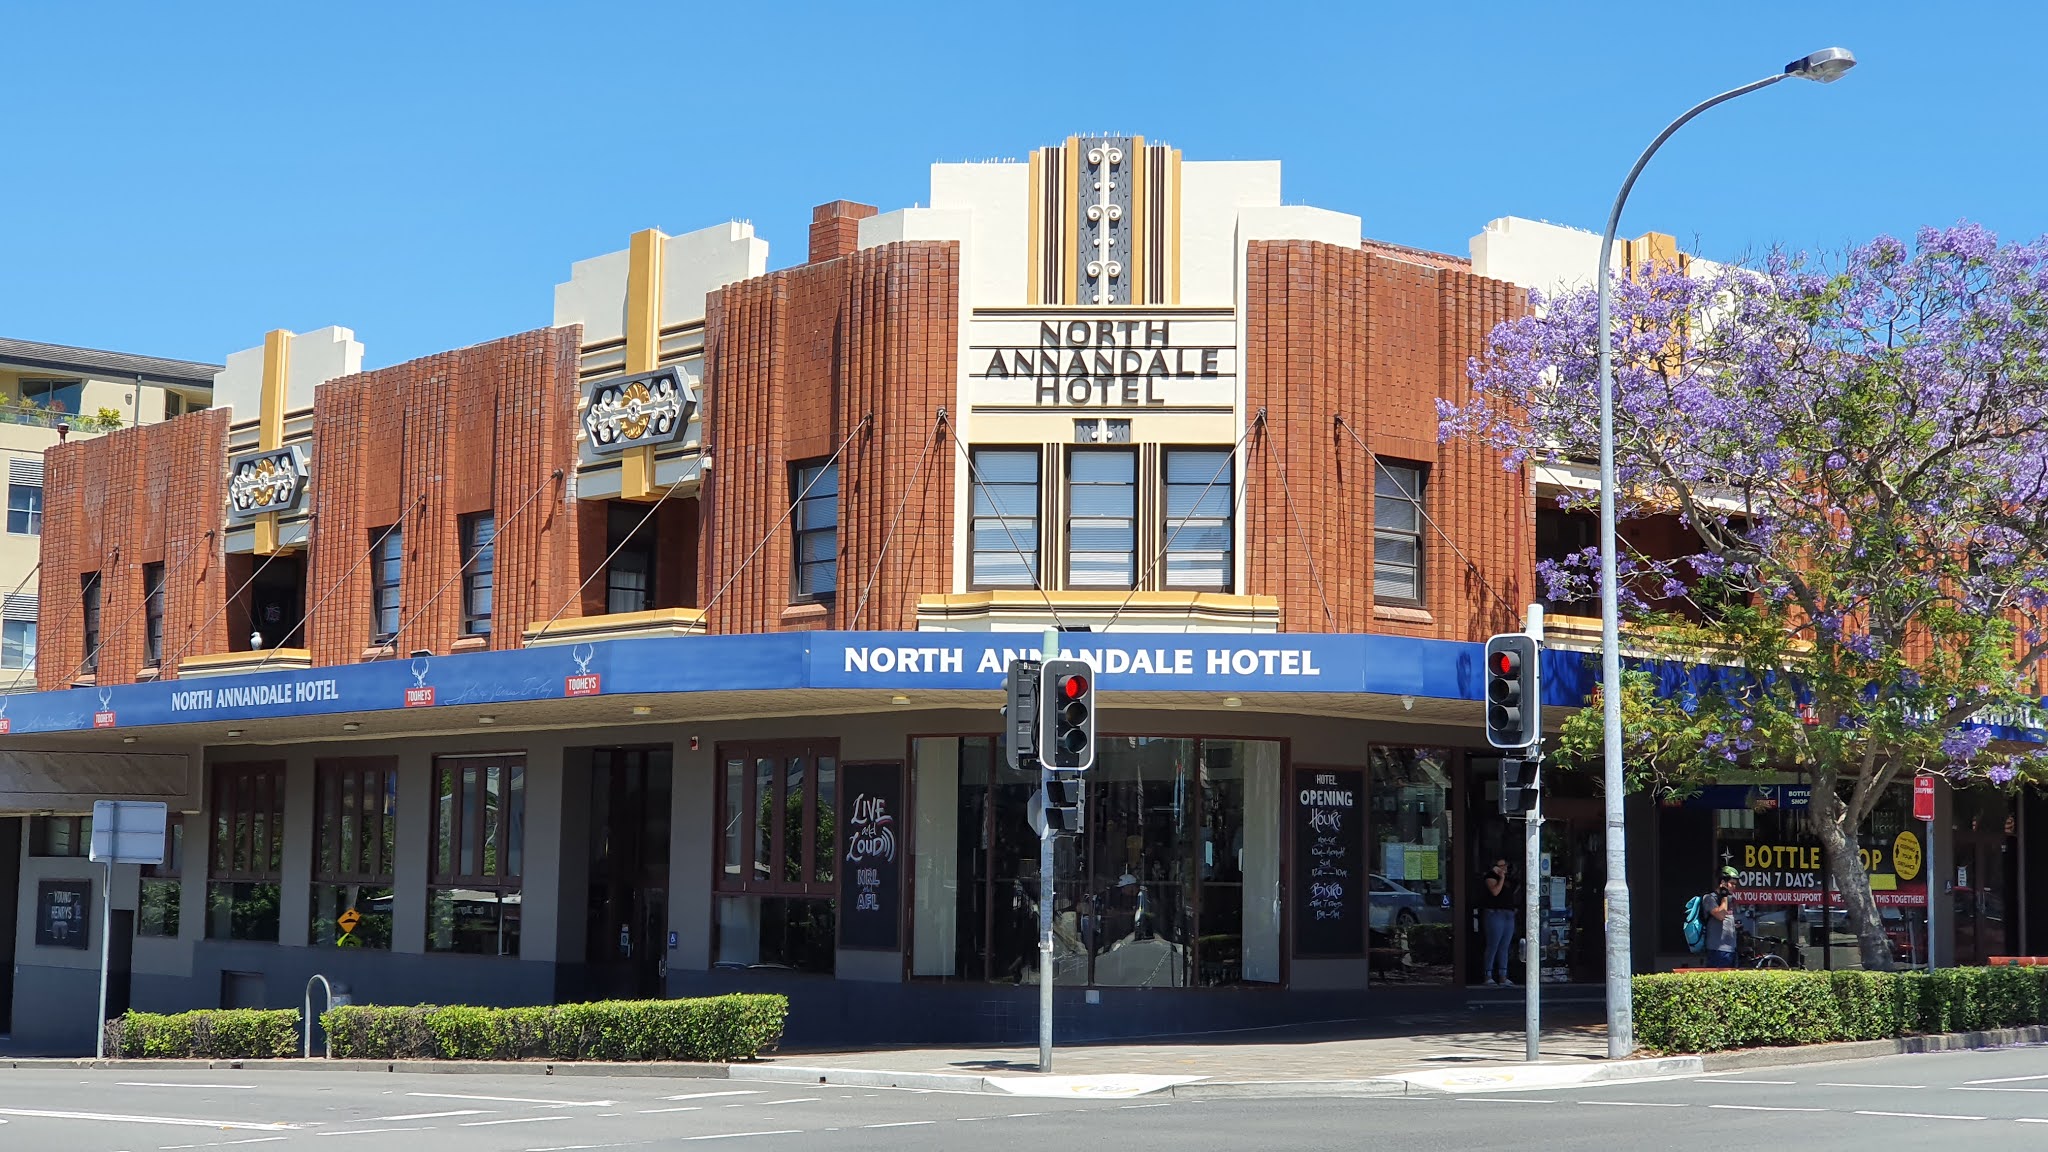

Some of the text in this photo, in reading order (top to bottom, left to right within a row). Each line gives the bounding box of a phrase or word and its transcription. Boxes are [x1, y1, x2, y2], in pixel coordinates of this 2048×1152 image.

[1040, 320, 1169, 349] NORTH
[986, 348, 1219, 379] ANNANDALE
[1036, 378, 1165, 405] HOTEL
[844, 647, 963, 673] NORTH
[1206, 650, 1320, 675] HOTEL
[568, 677, 597, 690] TOOHEYS
[171, 679, 339, 711] NORTH ANNANDALE HOTEL
[407, 689, 431, 702] TOOHEYS
[1316, 774, 1338, 785] HOTEL
[1300, 789, 1353, 806] OPENING
[851, 793, 893, 824] LIVE
[846, 832, 884, 861] LOUD
[1745, 845, 1821, 869] BOTTLE
[857, 869, 880, 885] NRL
[1739, 871, 1771, 887] OPEN
[1775, 872, 1782, 887] 7
[1785, 873, 1814, 888] DAYS
[53, 891, 72, 903] YOUNG
[856, 894, 879, 911] AFL
[1743, 892, 1758, 901] YOU
[1760, 892, 1772, 901] FOR
[1774, 893, 1791, 902] YOUR
[1793, 893, 1822, 902] SUPPORT
[1876, 894, 1890, 904] THIS
[1891, 895, 1924, 904] TOGETHER!
[51, 905, 72, 919] HENRYS
